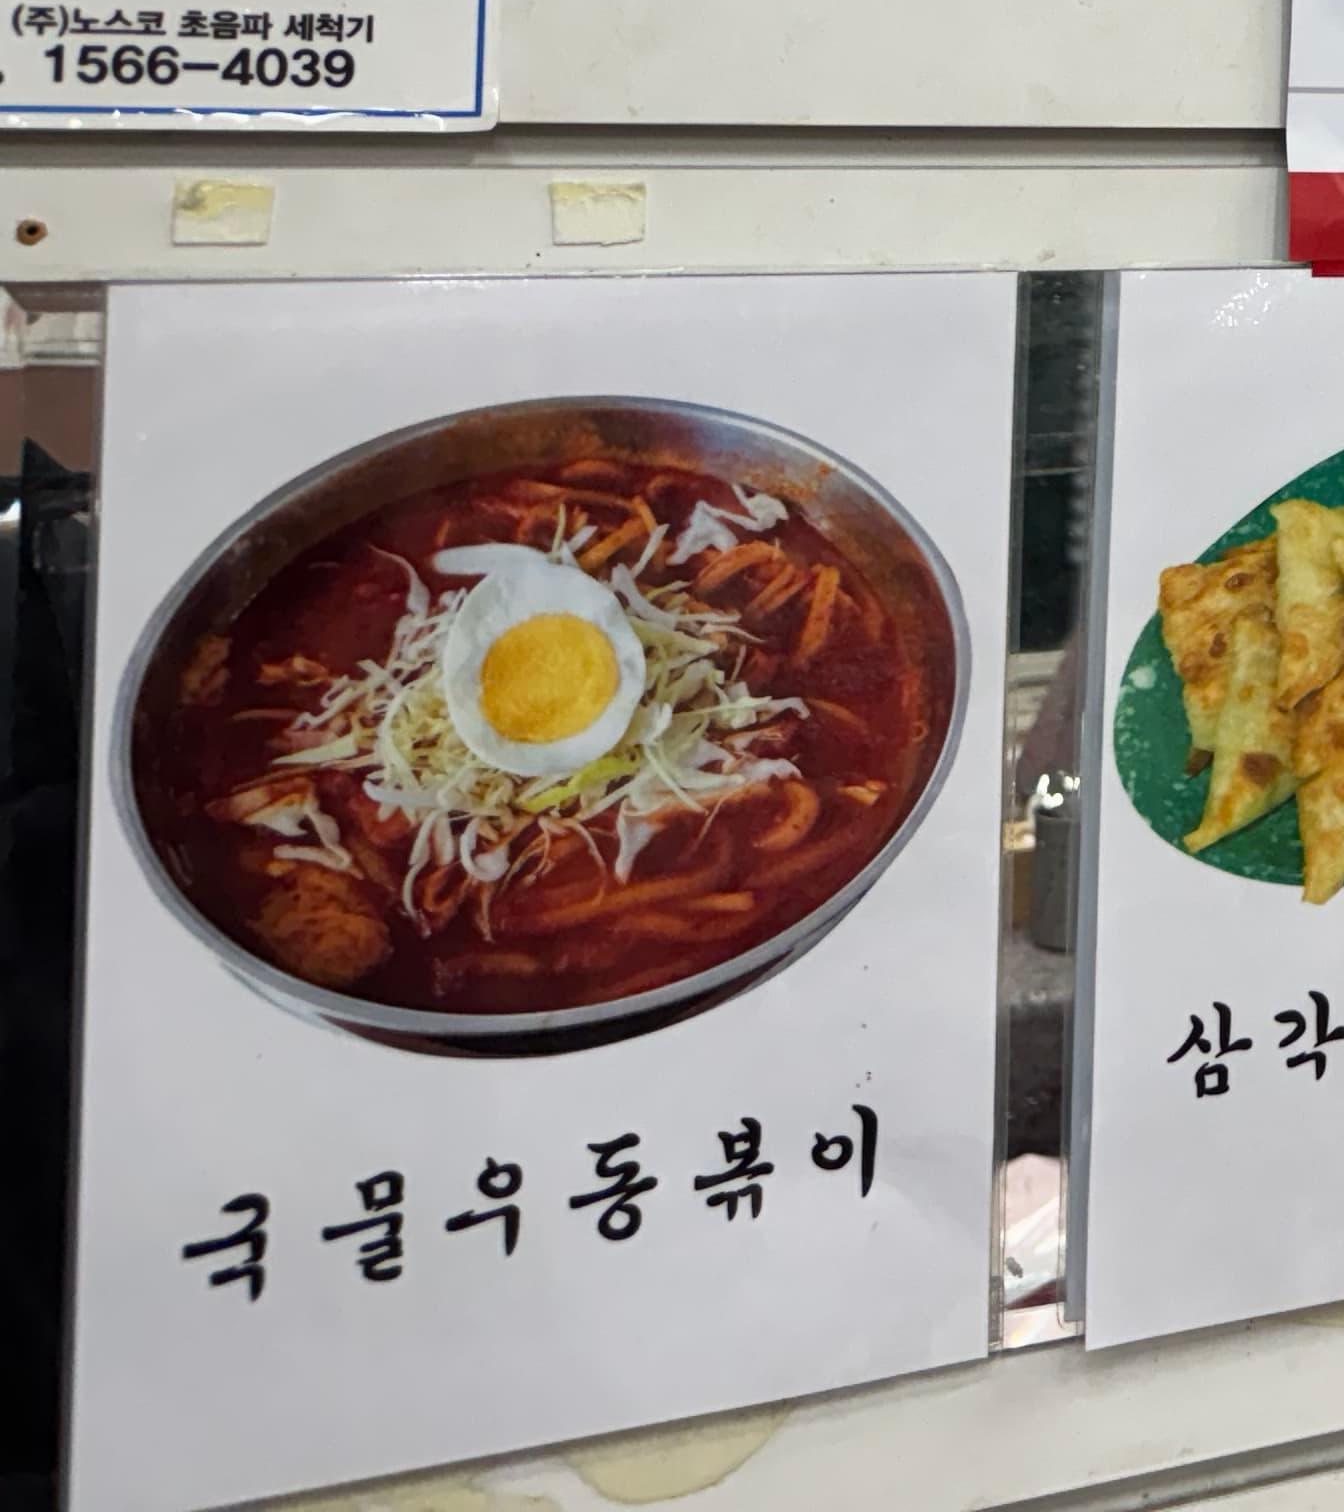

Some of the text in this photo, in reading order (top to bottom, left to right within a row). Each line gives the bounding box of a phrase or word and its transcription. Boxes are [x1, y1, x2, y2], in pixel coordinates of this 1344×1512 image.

[11, 3, 375, 43] (주)노스코 초음파 세척기
[44, 43, 357, 89] 1566-4039
